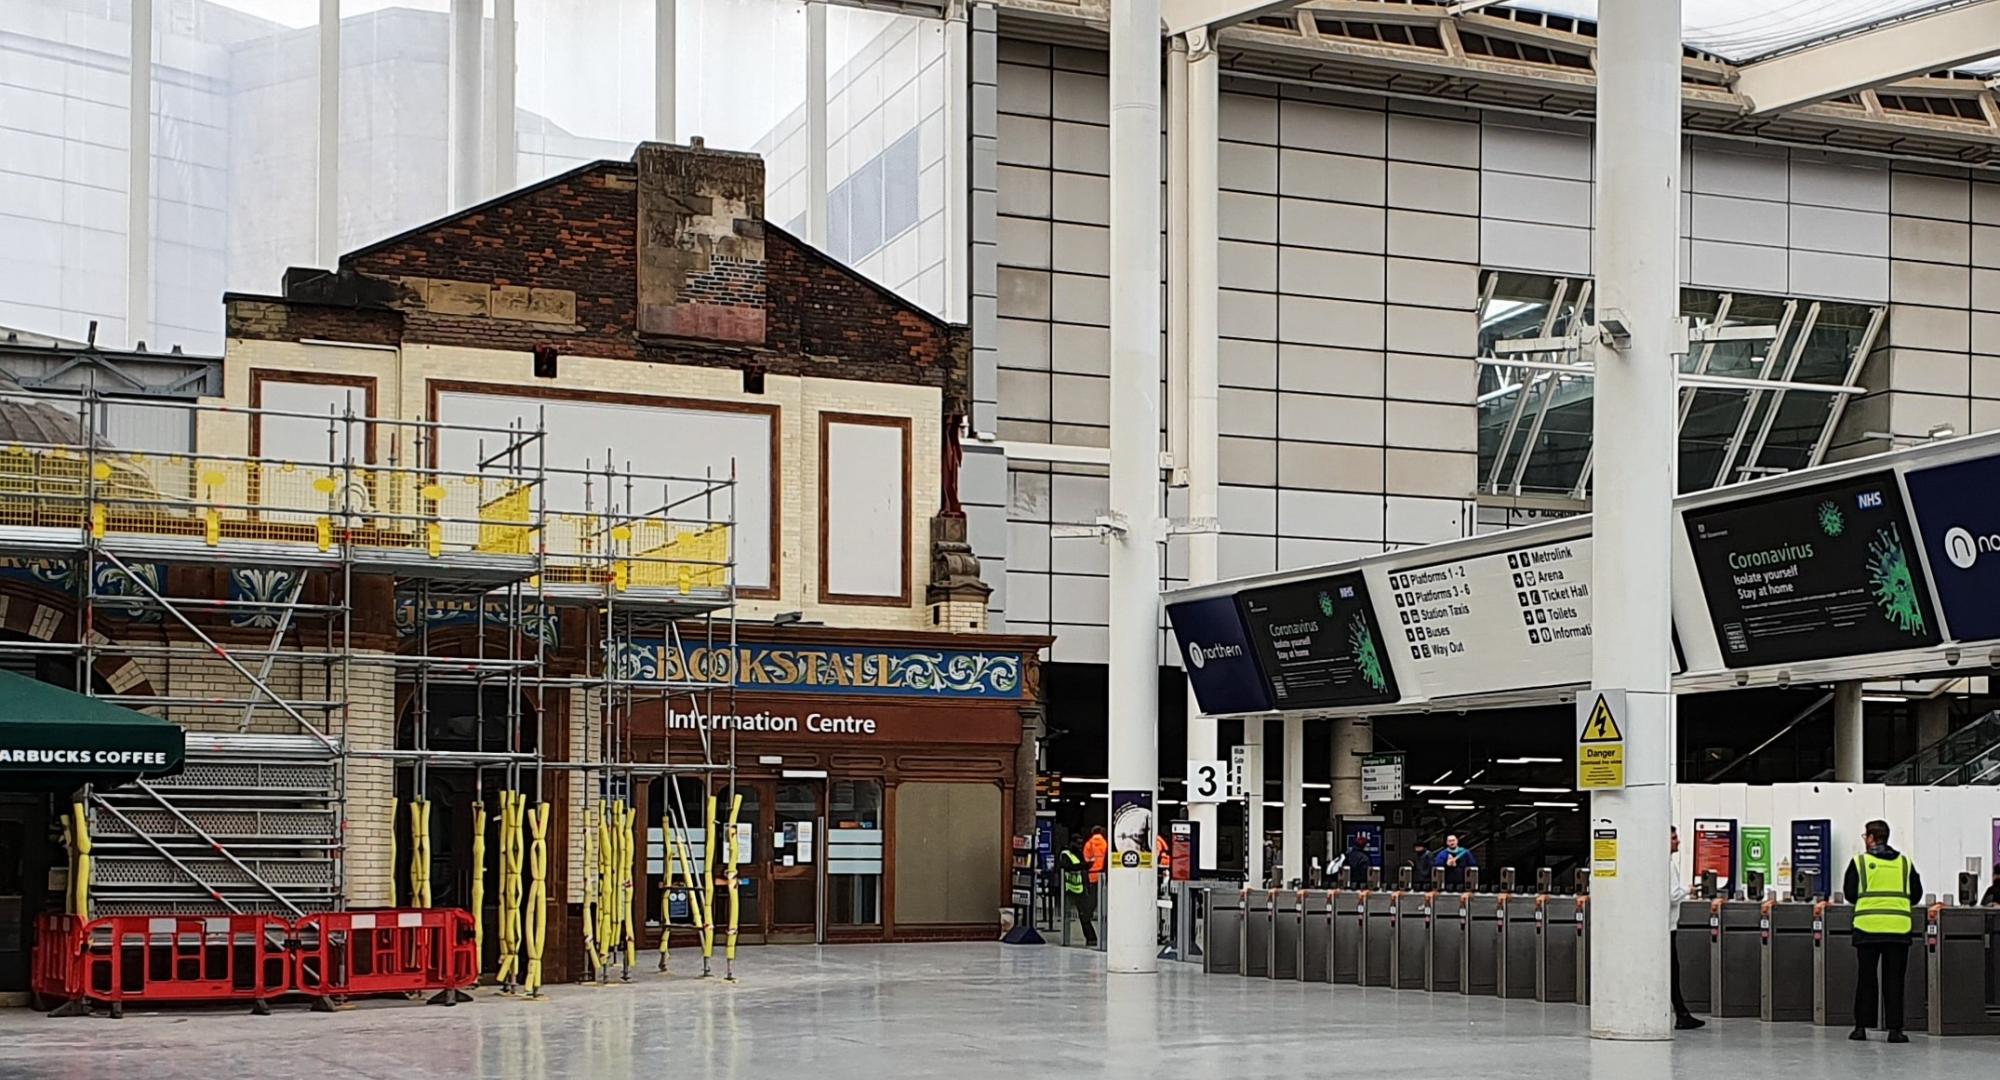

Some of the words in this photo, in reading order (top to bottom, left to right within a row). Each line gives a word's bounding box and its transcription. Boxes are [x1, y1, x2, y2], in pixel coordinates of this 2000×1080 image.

[1858, 491, 1882, 509] NHS
[1531, 546, 1573, 564] Metrolink
[1728, 542, 1814, 570] Coronavirus
[1410, 571, 1447, 586] Platforms
[1447, 567, 1454, 579] 1
[1458, 565, 1466, 577] 2
[1538, 570, 1564, 583] Arena
[1733, 570, 1762, 586] Isolate
[1763, 564, 1799, 583] yourself
[1339, 586, 1355, 598] NHS
[1414, 589, 1453, 604] Platforms
[1452, 585, 1459, 597] 3
[1464, 583, 1471, 595] 6
[1541, 587, 1570, 602] Ticket
[1570, 583, 1589, 598] Hall
[1737, 587, 1757, 600] Stay
[1758, 584, 1768, 597] at
[1768, 581, 1794, 595] home
[1420, 607, 1449, 621] Station
[1448, 603, 1470, 616] Taxis
[1547, 607, 1577, 620] Toilets
[1269, 620, 1319, 637] Coronavirus
[1425, 626, 1451, 638] Buses
[1203, 643, 1242, 660] northern
[1431, 643, 1449, 657] Way
[1449, 641, 1464, 653] Out
[655, 645, 902, 688] BOOKSTALL
[668, 709, 798, 732] Information
[806, 713, 876, 734] Centre
[94, 751, 166, 765] COFFEE
[1587, 749, 1615, 759] Danger
[1198, 766, 1217, 797] 3
